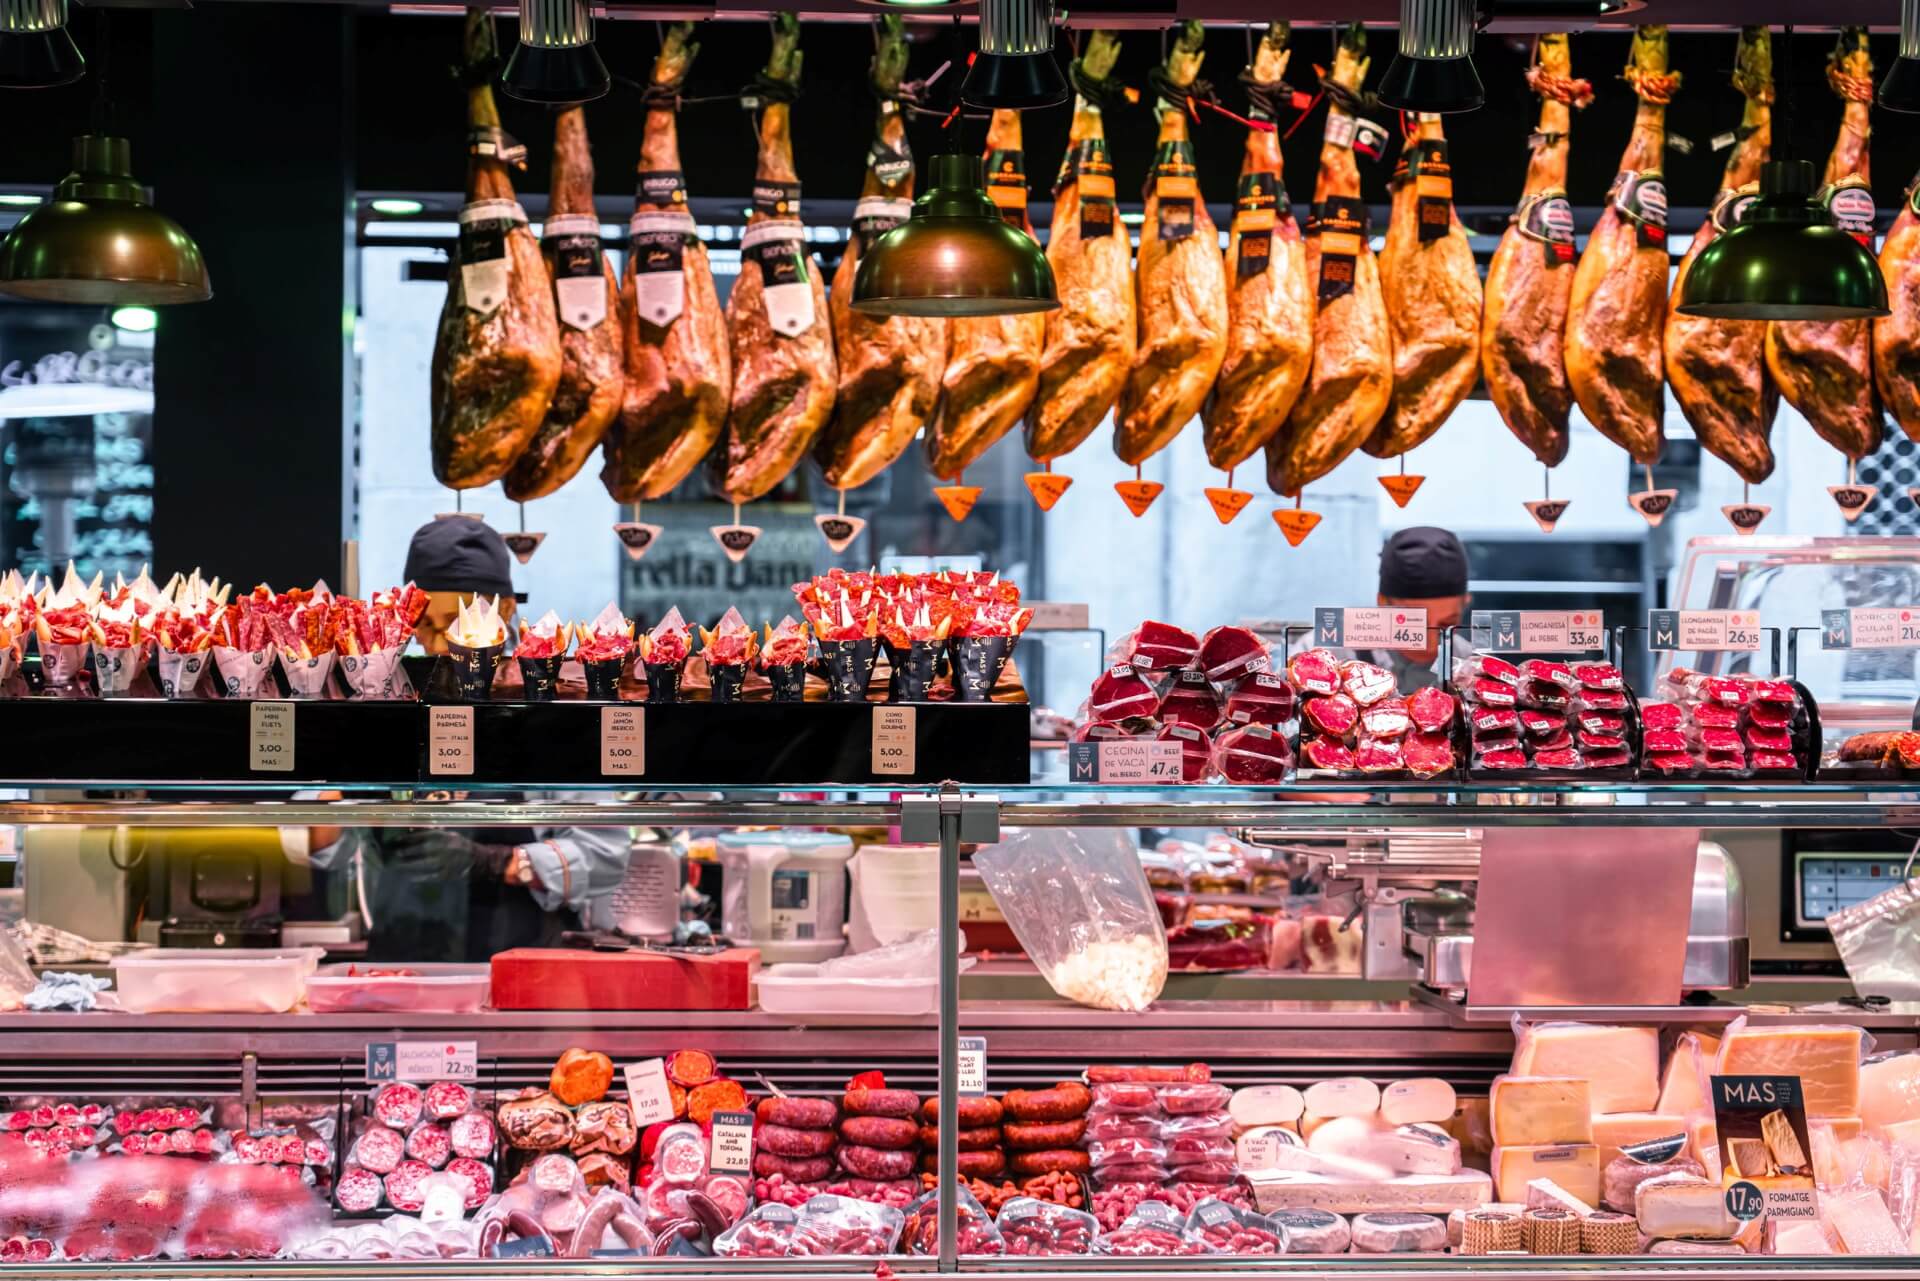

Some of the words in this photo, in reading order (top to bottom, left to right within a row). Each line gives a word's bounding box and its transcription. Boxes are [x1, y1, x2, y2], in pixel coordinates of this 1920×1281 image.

[1394, 629, 1423, 642] 46,30
[1570, 632, 1599, 645] 33,60
[1728, 631, 1759, 643] 26,15
[438, 748, 461, 757] 3,00
[610, 748, 632, 757] 5,00
[880, 748, 903, 756] 5,00
[1105, 747, 1145, 756] CECINA
[1117, 758, 1145, 767] VACA
[1724, 1082, 1776, 1103] MAS
[1769, 1193, 1810, 1203] FORMATGE
[1767, 1206, 1815, 1217] PARMIGIANO
